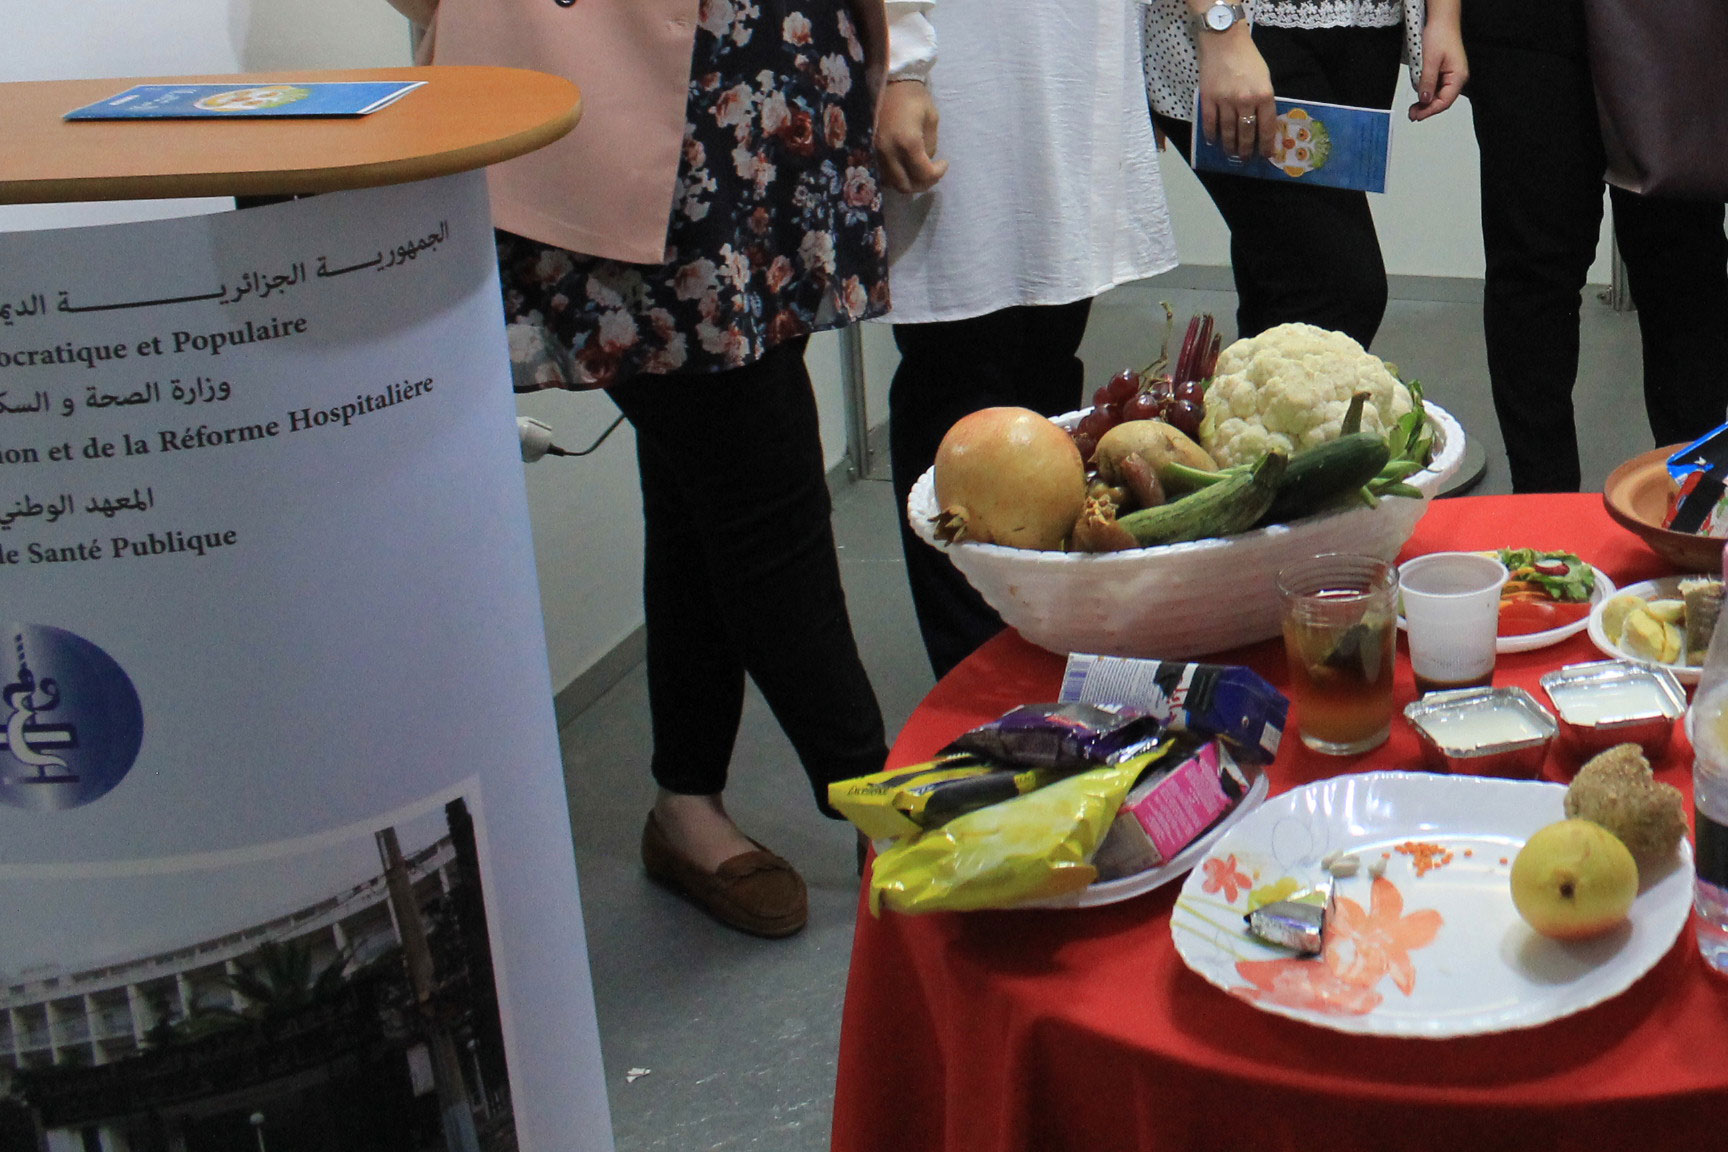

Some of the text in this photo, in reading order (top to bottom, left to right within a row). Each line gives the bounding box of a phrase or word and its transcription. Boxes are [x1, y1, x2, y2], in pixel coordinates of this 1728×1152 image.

[136, 313, 308, 357] et Populaire
[48, 375, 434, 462] et de la Réforme Hospitalière
[61, 376, 232, 417] وزارة الصحة و
[0, 487, 154, 531] المعهد الوطني
[29, 527, 237, 565] Santé Publique
